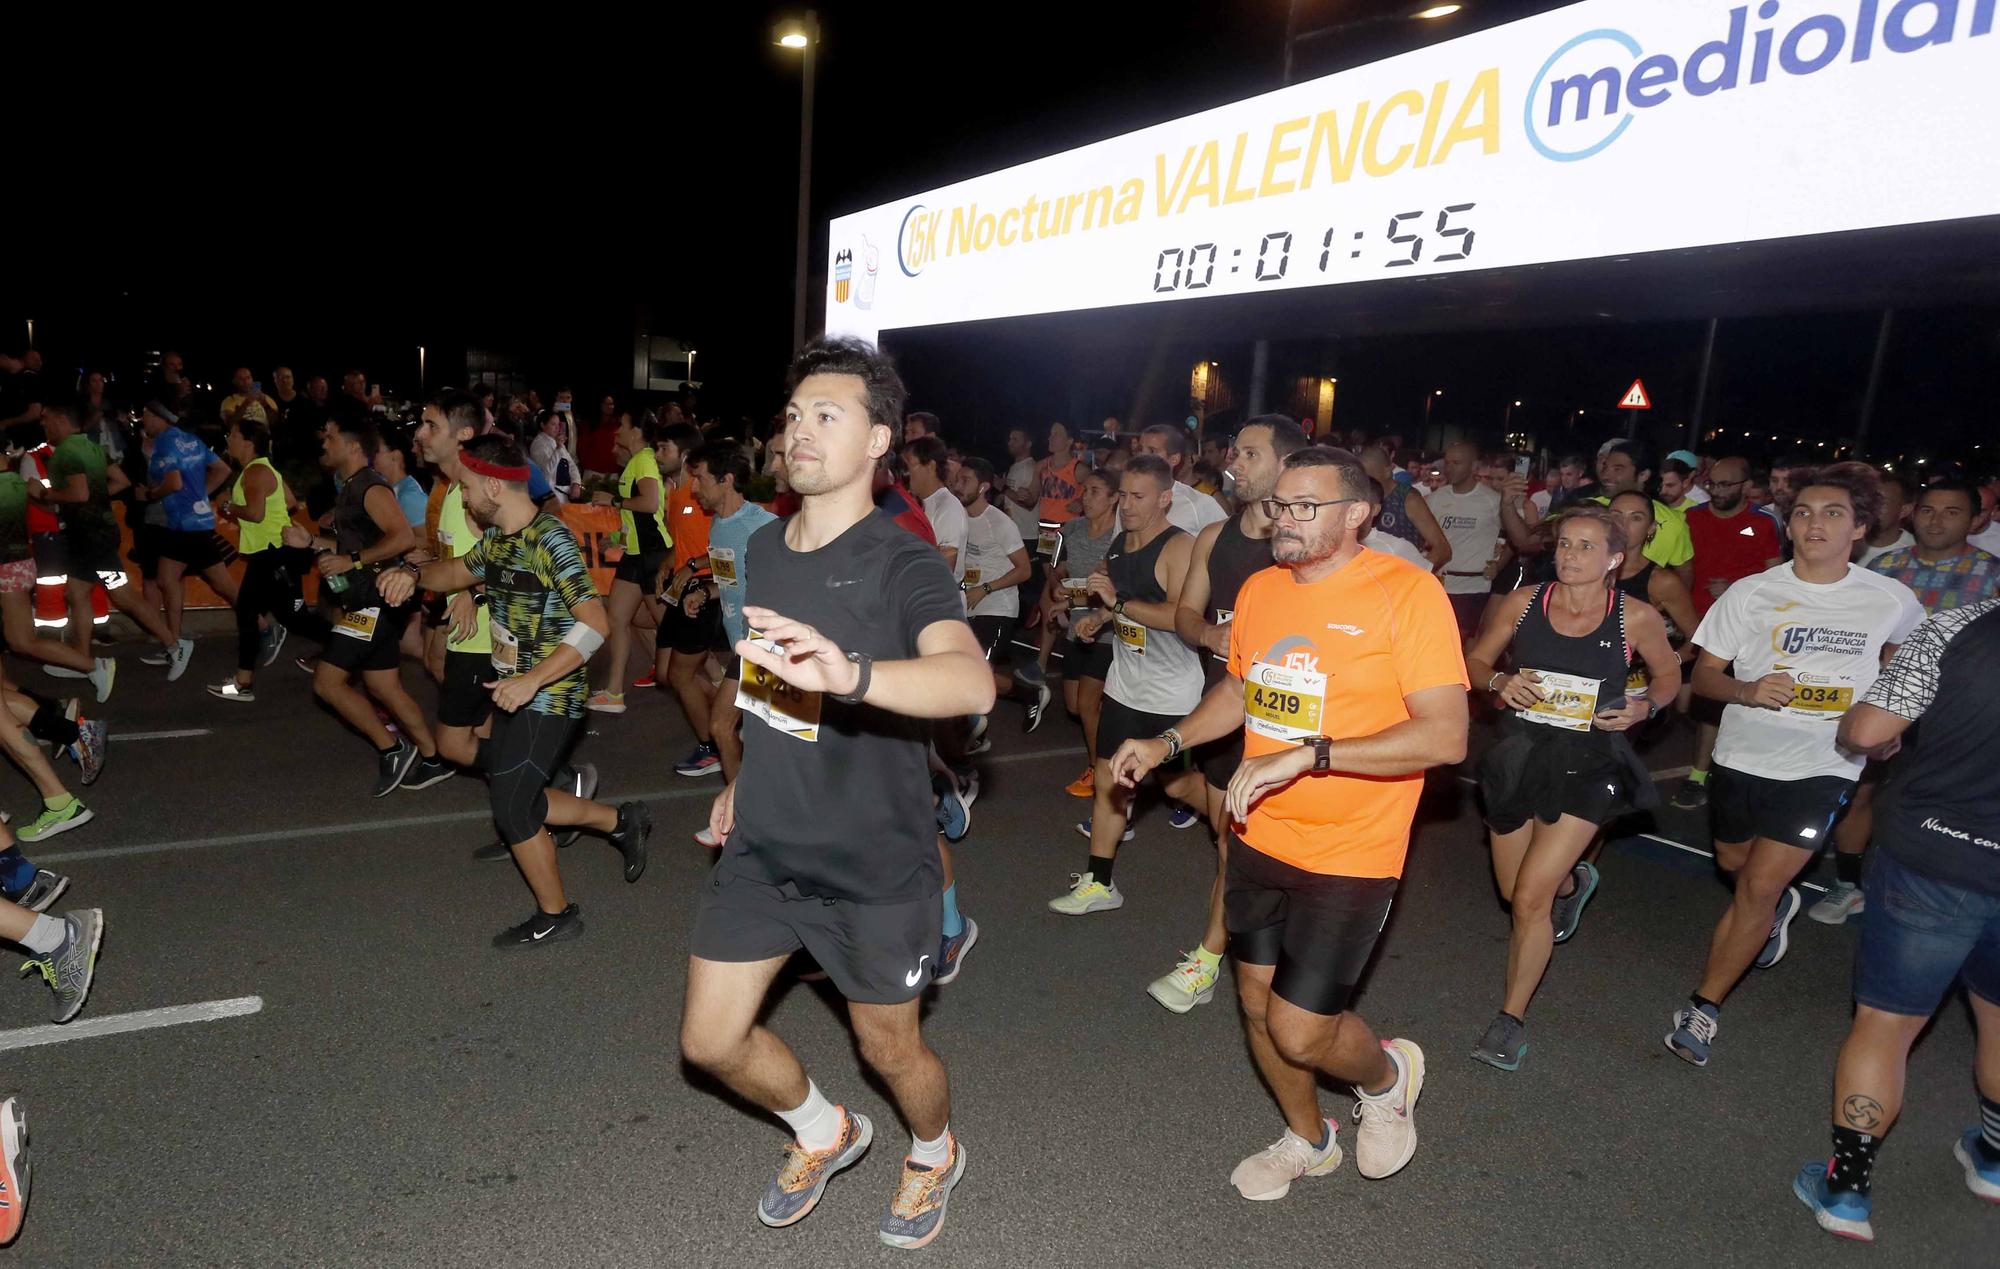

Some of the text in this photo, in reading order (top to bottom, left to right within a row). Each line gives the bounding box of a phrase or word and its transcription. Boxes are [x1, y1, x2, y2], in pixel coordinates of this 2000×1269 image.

[906, 208, 942, 268] 15K
[945, 177, 1144, 257] Nocturna
[1154, 67, 1500, 217] VALENCIA
[1153, 203, 1476, 293] 00:01:55
[1816, 635, 1866, 647] VALENCIA
[1818, 627, 1868, 639] Nocturna
[1805, 643, 1863, 656] mediolanum
[1254, 688, 1300, 715] 4.219
[1793, 688, 1839, 702] .034
[1920, 817, 1970, 840] Nunca
